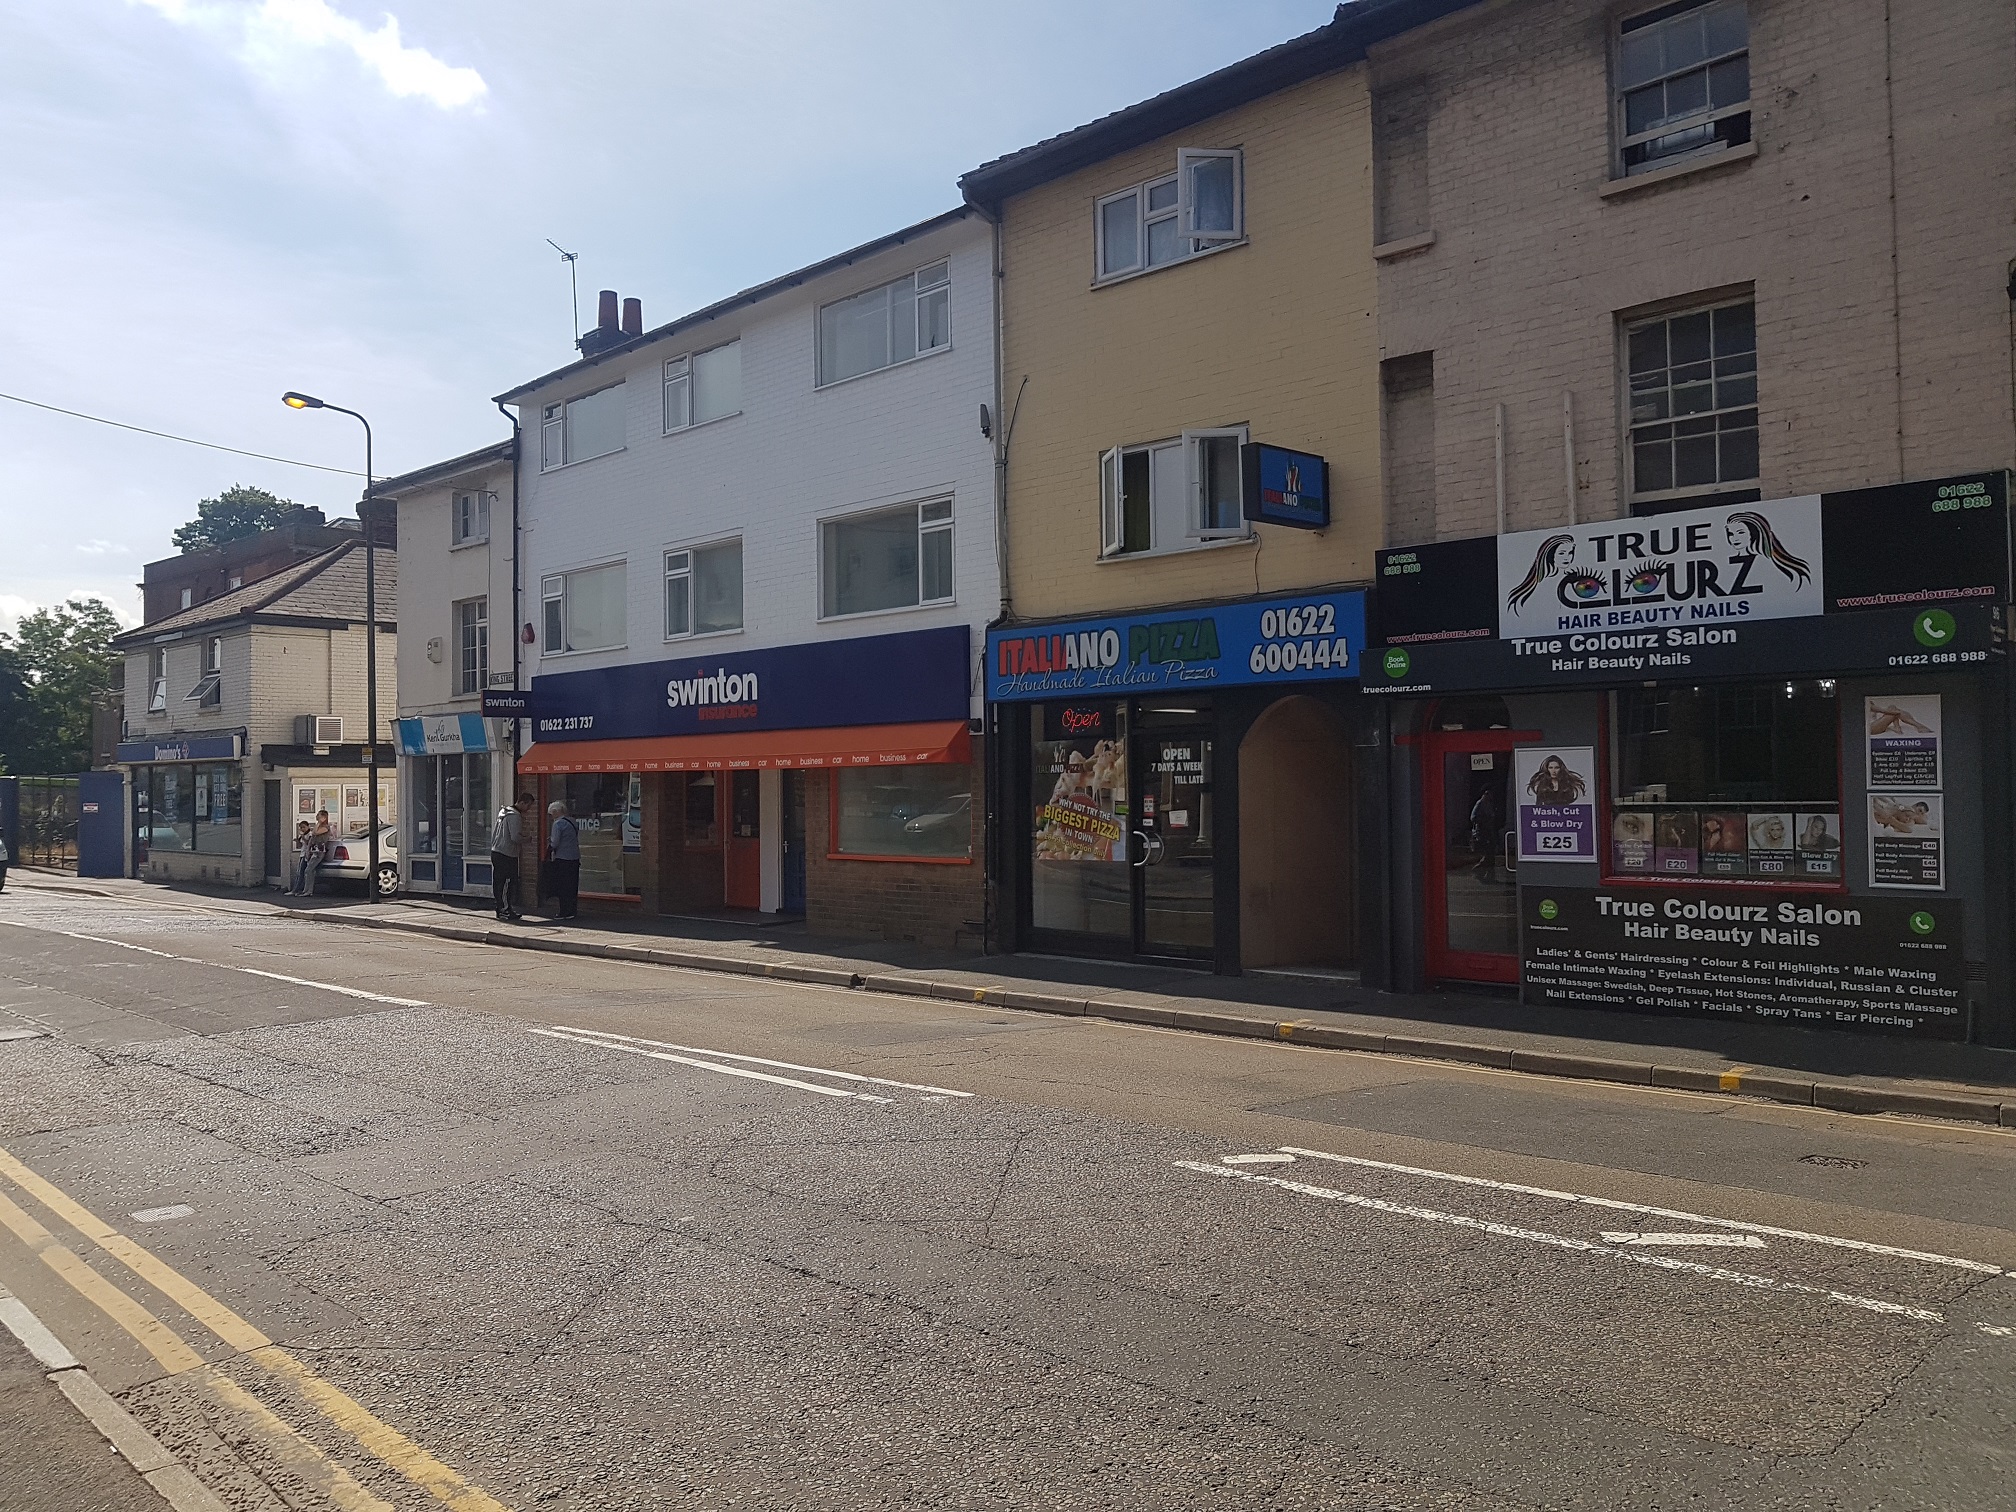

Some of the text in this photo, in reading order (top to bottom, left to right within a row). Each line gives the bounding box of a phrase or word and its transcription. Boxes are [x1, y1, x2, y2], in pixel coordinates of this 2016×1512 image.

[1939, 482, 1985, 497] 01622
[1932, 495, 1992, 512] 688 988
[1588, 523, 1712, 562] TRUE
[1387, 553, 1417, 565] 01622
[1403, 563, 1421, 574] 988
[1837, 585, 1995, 607] www.truecolourz.com
[1261, 603, 1335, 639] 01622
[1558, 601, 1750, 630] HAIR BEAUTY NAILS
[1387, 628, 1489, 644] www.truecolourz.com
[1511, 627, 1737, 656] True Colourz Salon
[998, 618, 1220, 676] ITALIANO PIZZA
[1249, 638, 1348, 674] 600444
[1552, 652, 1691, 671] Hair Beauty Nails
[1889, 651, 1986, 665] 01622 688 988
[997, 659, 1218, 696] Handmade Italian Pizza
[667, 668, 758, 707] swinton
[1363, 684, 1431, 694] truecolourz.com
[485, 697, 525, 707] swinton
[699, 704, 757, 720] insurance
[1062, 708, 1100, 733] Open
[540, 716, 594, 731] 01622 231 737
[664, 761, 684, 769] business
[706, 760, 721, 768] home
[729, 759, 749, 767] business
[775, 758, 792, 766] home
[800, 757, 823, 765] business
[832, 756, 842, 764] car
[852, 755, 869, 763] home
[879, 753, 906, 762] business
[916, 752, 928, 760] car
[1163, 748, 1190, 761] OPEN
[1151, 762, 1203, 772] 7 DAYS A WEEK
[1174, 775, 1203, 784] TILL LATE
[1058, 798, 1111, 821] WHY NOT TRY THE
[1532, 807, 1580, 816] Wash, Cut
[1044, 804, 1120, 841] BIGGEST PIZZA
[1531, 820, 1583, 829] & Blow Dry
[1065, 828, 1093, 843] IN TOWN
[1542, 836, 1572, 849] £25
[1667, 861, 1686, 869] £20
[1761, 862, 1783, 871] £80
[1595, 896, 1861, 926] True Colourz Salon
[1624, 922, 1820, 947] Hair Beauty Nails
[1536, 947, 1937, 982] Ladies' & Gents' Hairdressing Colour & Foil Highlights Male Waxing
[1525, 961, 1958, 998] Female Intimate Waxing Eyelash Extensions: Individual, Russian & Cluster
[1526, 975, 1958, 1015] Unisex Massage: Swedish, Deep Tissue, Hot Stones, Aromatherapy, Sports Massage
[1546, 989, 1914, 1028] Nail Extensions Gel Polish Facials Spray Tans Ear Piercing
